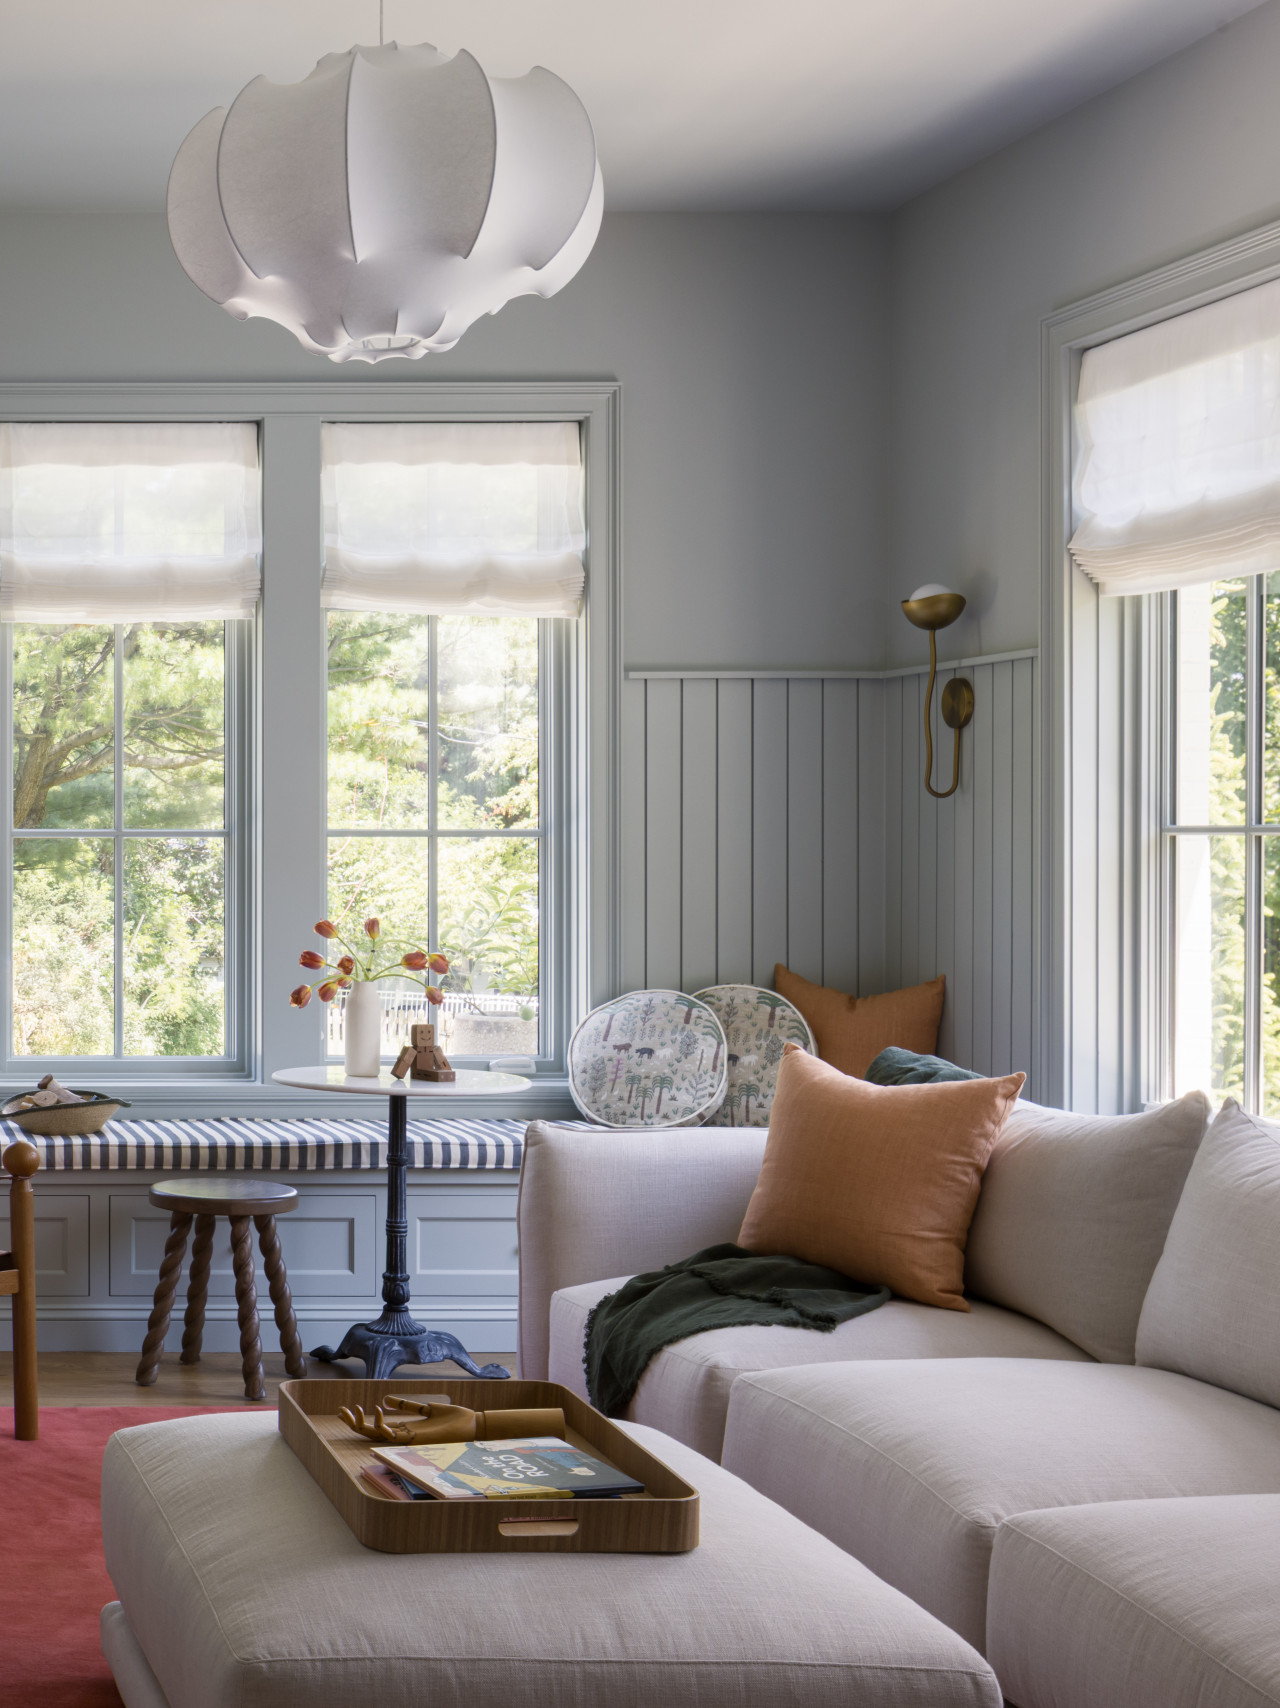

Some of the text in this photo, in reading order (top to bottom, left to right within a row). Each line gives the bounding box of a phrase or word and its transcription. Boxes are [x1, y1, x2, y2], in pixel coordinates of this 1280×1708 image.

[482, 1456, 507, 1468] the
[499, 1454, 550, 1477] ROAD
[501, 1467, 525, 1479] On
